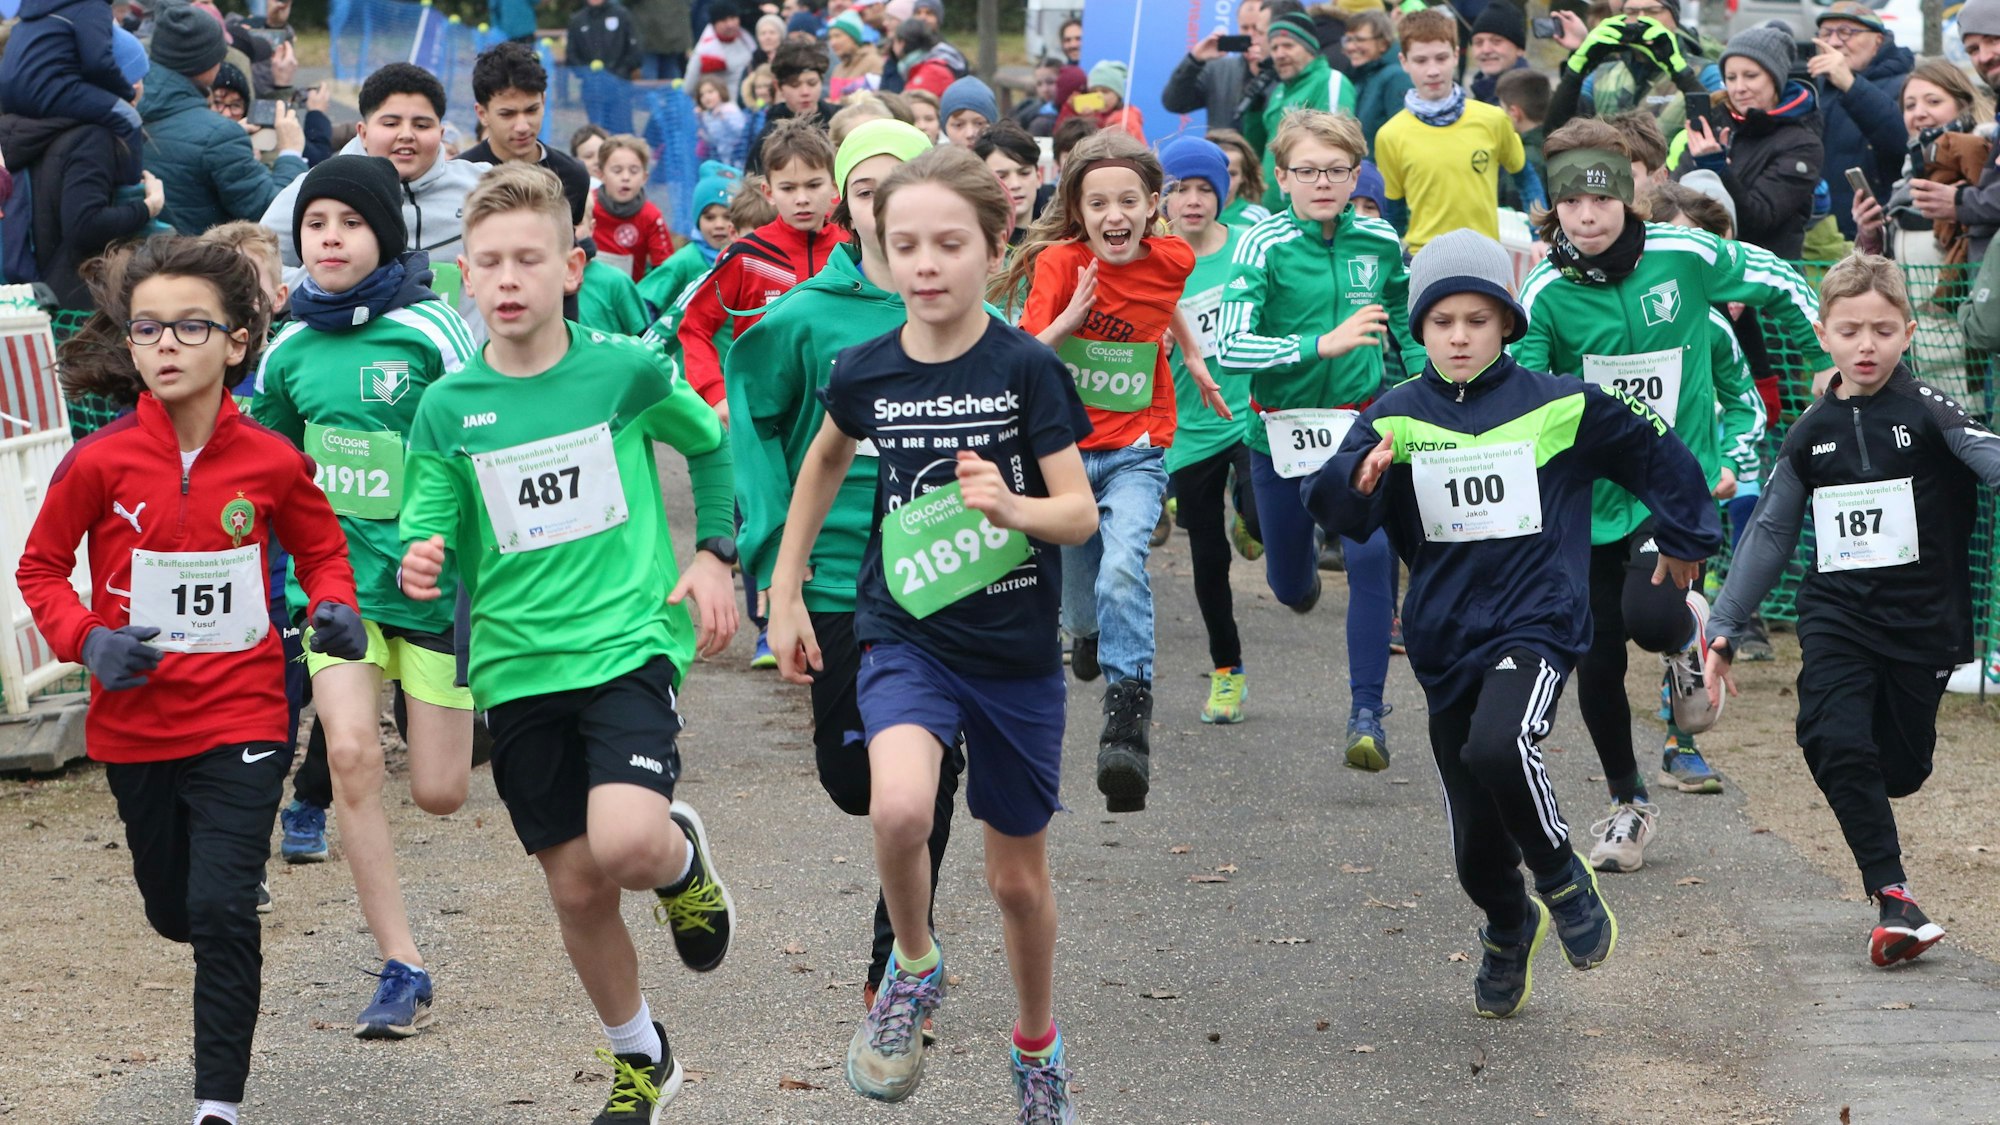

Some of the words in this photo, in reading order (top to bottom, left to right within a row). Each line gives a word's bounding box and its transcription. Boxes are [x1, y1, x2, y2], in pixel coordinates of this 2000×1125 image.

[1092, 347, 1134, 357] COLOGNE
[1064, 363, 1147, 395] 21909
[874, 390, 1019, 422] SportScheck
[463, 412, 497, 428] JAKO
[328, 435, 370, 449] COLOGNE
[902, 437, 925, 448] BRE
[933, 437, 959, 448] DRS
[967, 434, 991, 447] ERF
[1292, 428, 1332, 450] 310
[1892, 425, 1912, 448] 16
[340, 447, 370, 456] TIMING
[495, 445, 555, 466] Raiffeisenbank
[1812, 442, 1836, 455] JAKO
[519, 455, 569, 473] Silvesterlauf
[1430, 453, 1482, 465] Raiffeisenbank
[1449, 462, 1494, 474] Silvesterlauf
[313, 462, 390, 497] 21912
[1010, 454, 1026, 492] 2023
[518, 466, 580, 509] 487
[1445, 474, 1504, 507] 100
[905, 493, 959, 525] COLOGNE
[924, 505, 963, 527] TIMING
[1465, 510, 1488, 518] Jakob
[1835, 508, 1883, 538] 187
[158, 558, 219, 568] Raiffeisenbank
[221, 554, 246, 566] Voreifel
[895, 517, 1009, 595] 21898
[180, 570, 230, 579] Silvesterlauf
[987, 576, 1038, 595] EDITION
[172, 582, 232, 616] 151
[191, 620, 216, 628] Yusuf
[629, 754, 663, 774] JAKO
